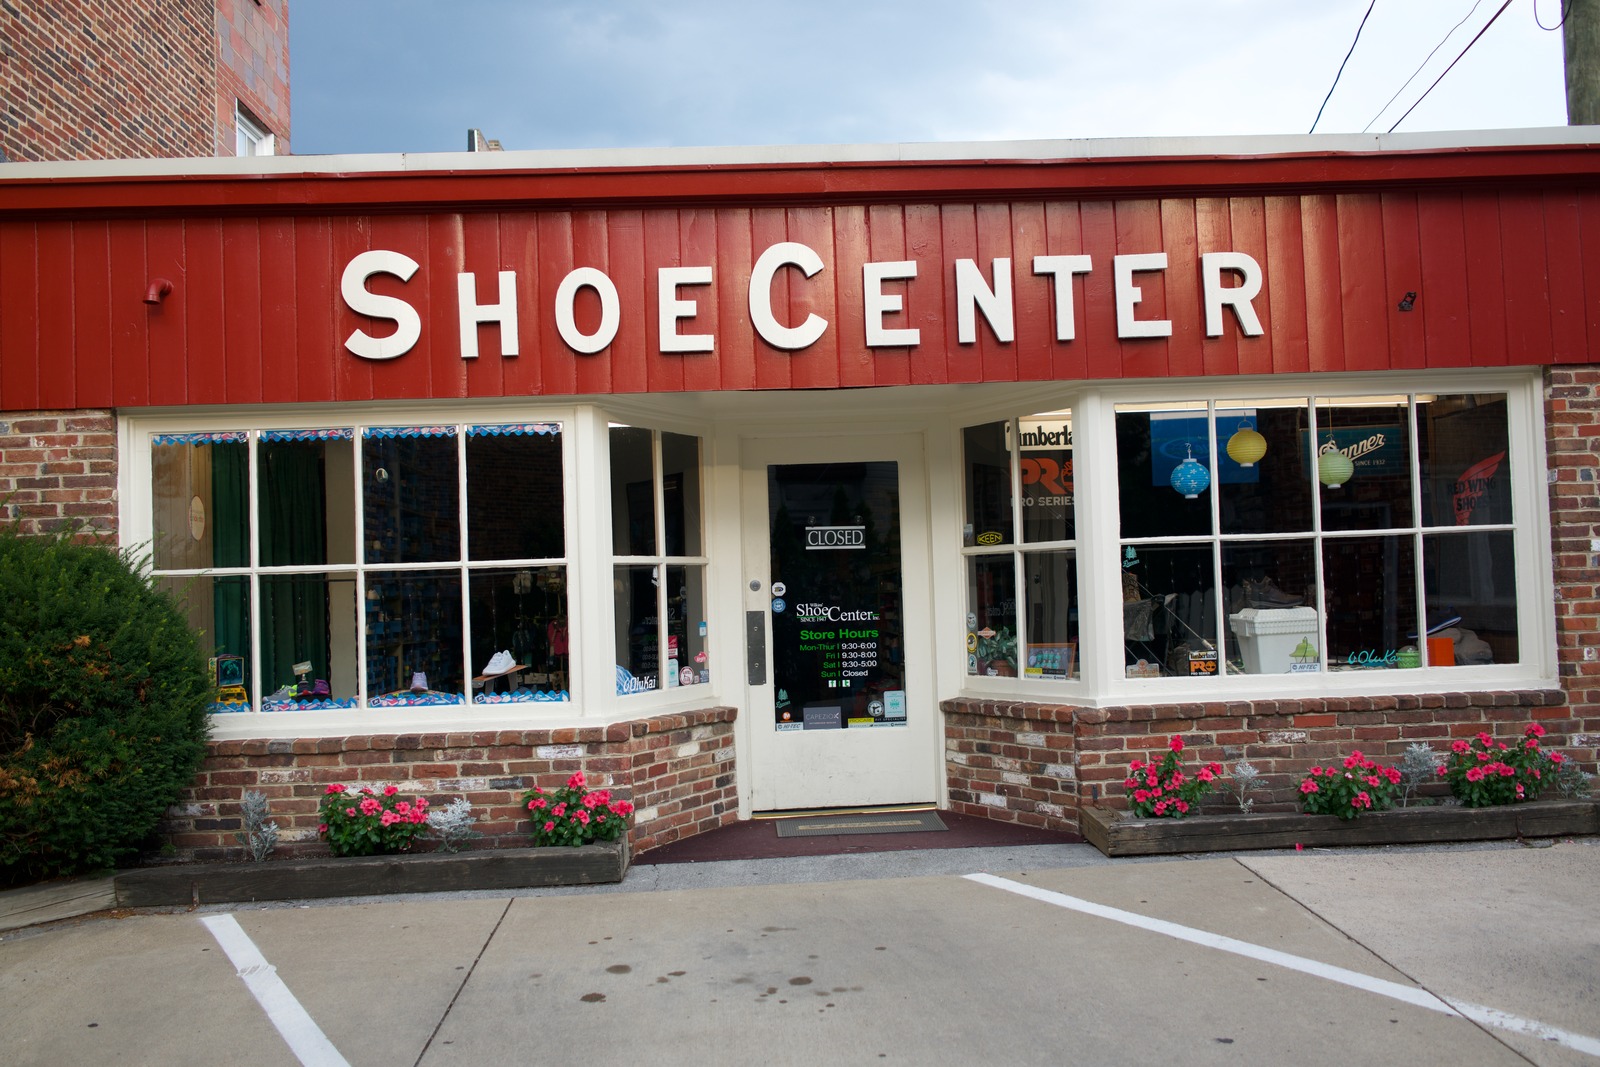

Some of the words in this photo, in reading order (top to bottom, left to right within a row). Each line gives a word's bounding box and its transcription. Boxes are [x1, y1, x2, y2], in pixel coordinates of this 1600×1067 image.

[1447, 480, 1466, 496] RED
[1468, 477, 1497, 492] WING
[1011, 497, 1034, 507] RO
[807, 530, 863, 546] CLOSED
[978, 533, 1001, 544] KEEN
[800, 629, 835, 640] Store
[839, 628, 879, 639] Hours
[800, 643, 836, 651] Mon-Thur
[841, 642, 877, 650] 9:30-6:00
[841, 651, 877, 659] 9:30-8:00
[823, 661, 836, 669] Sat
[842, 660, 878, 668] 9:30-5:00
